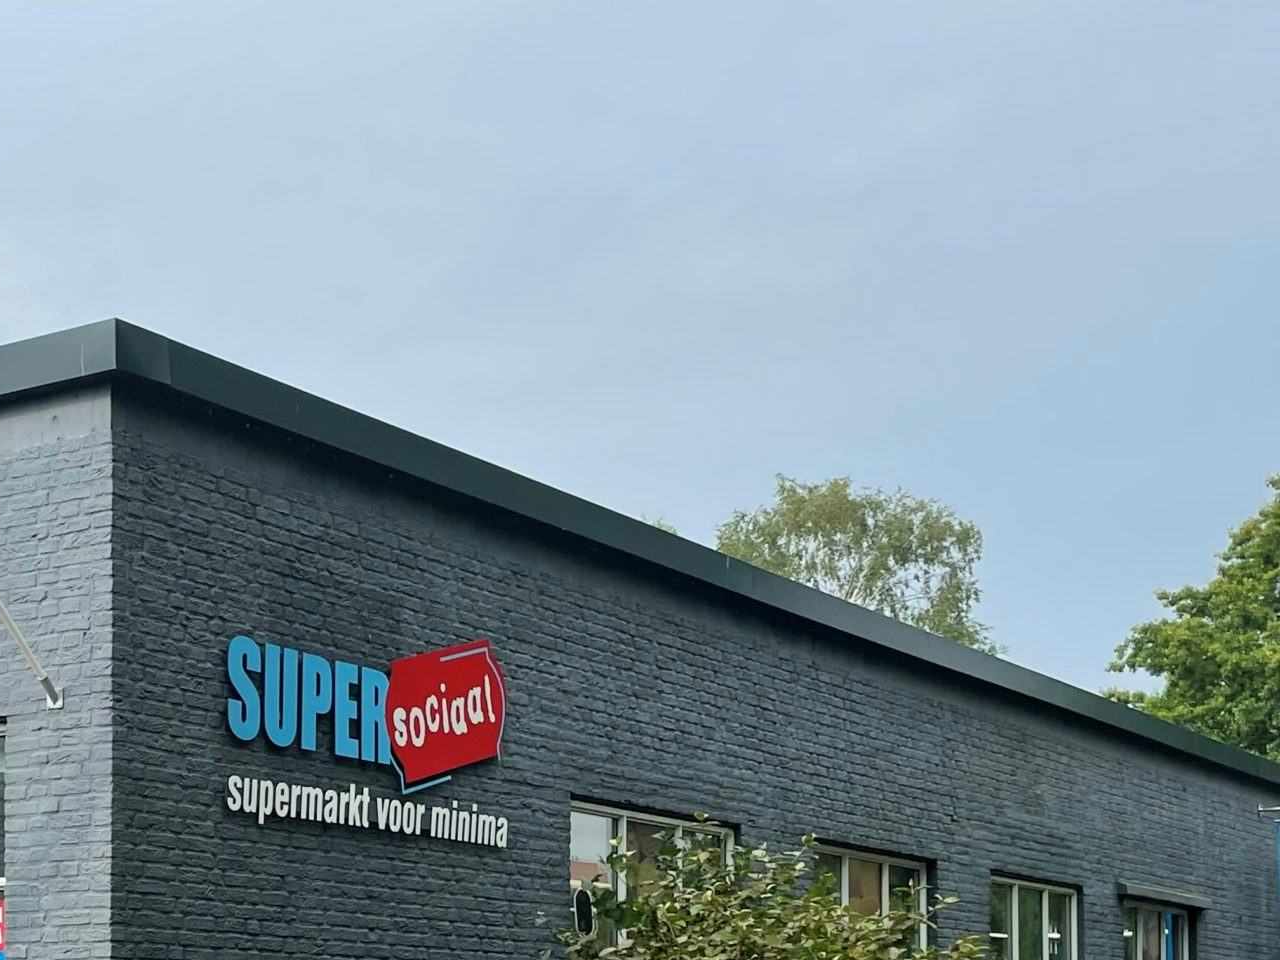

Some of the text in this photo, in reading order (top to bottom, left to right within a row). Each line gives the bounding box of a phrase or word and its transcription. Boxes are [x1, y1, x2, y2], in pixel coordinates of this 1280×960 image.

[227, 635, 496, 765] SUPER sociaal
[227, 774, 509, 849] supermarkt voor minima
